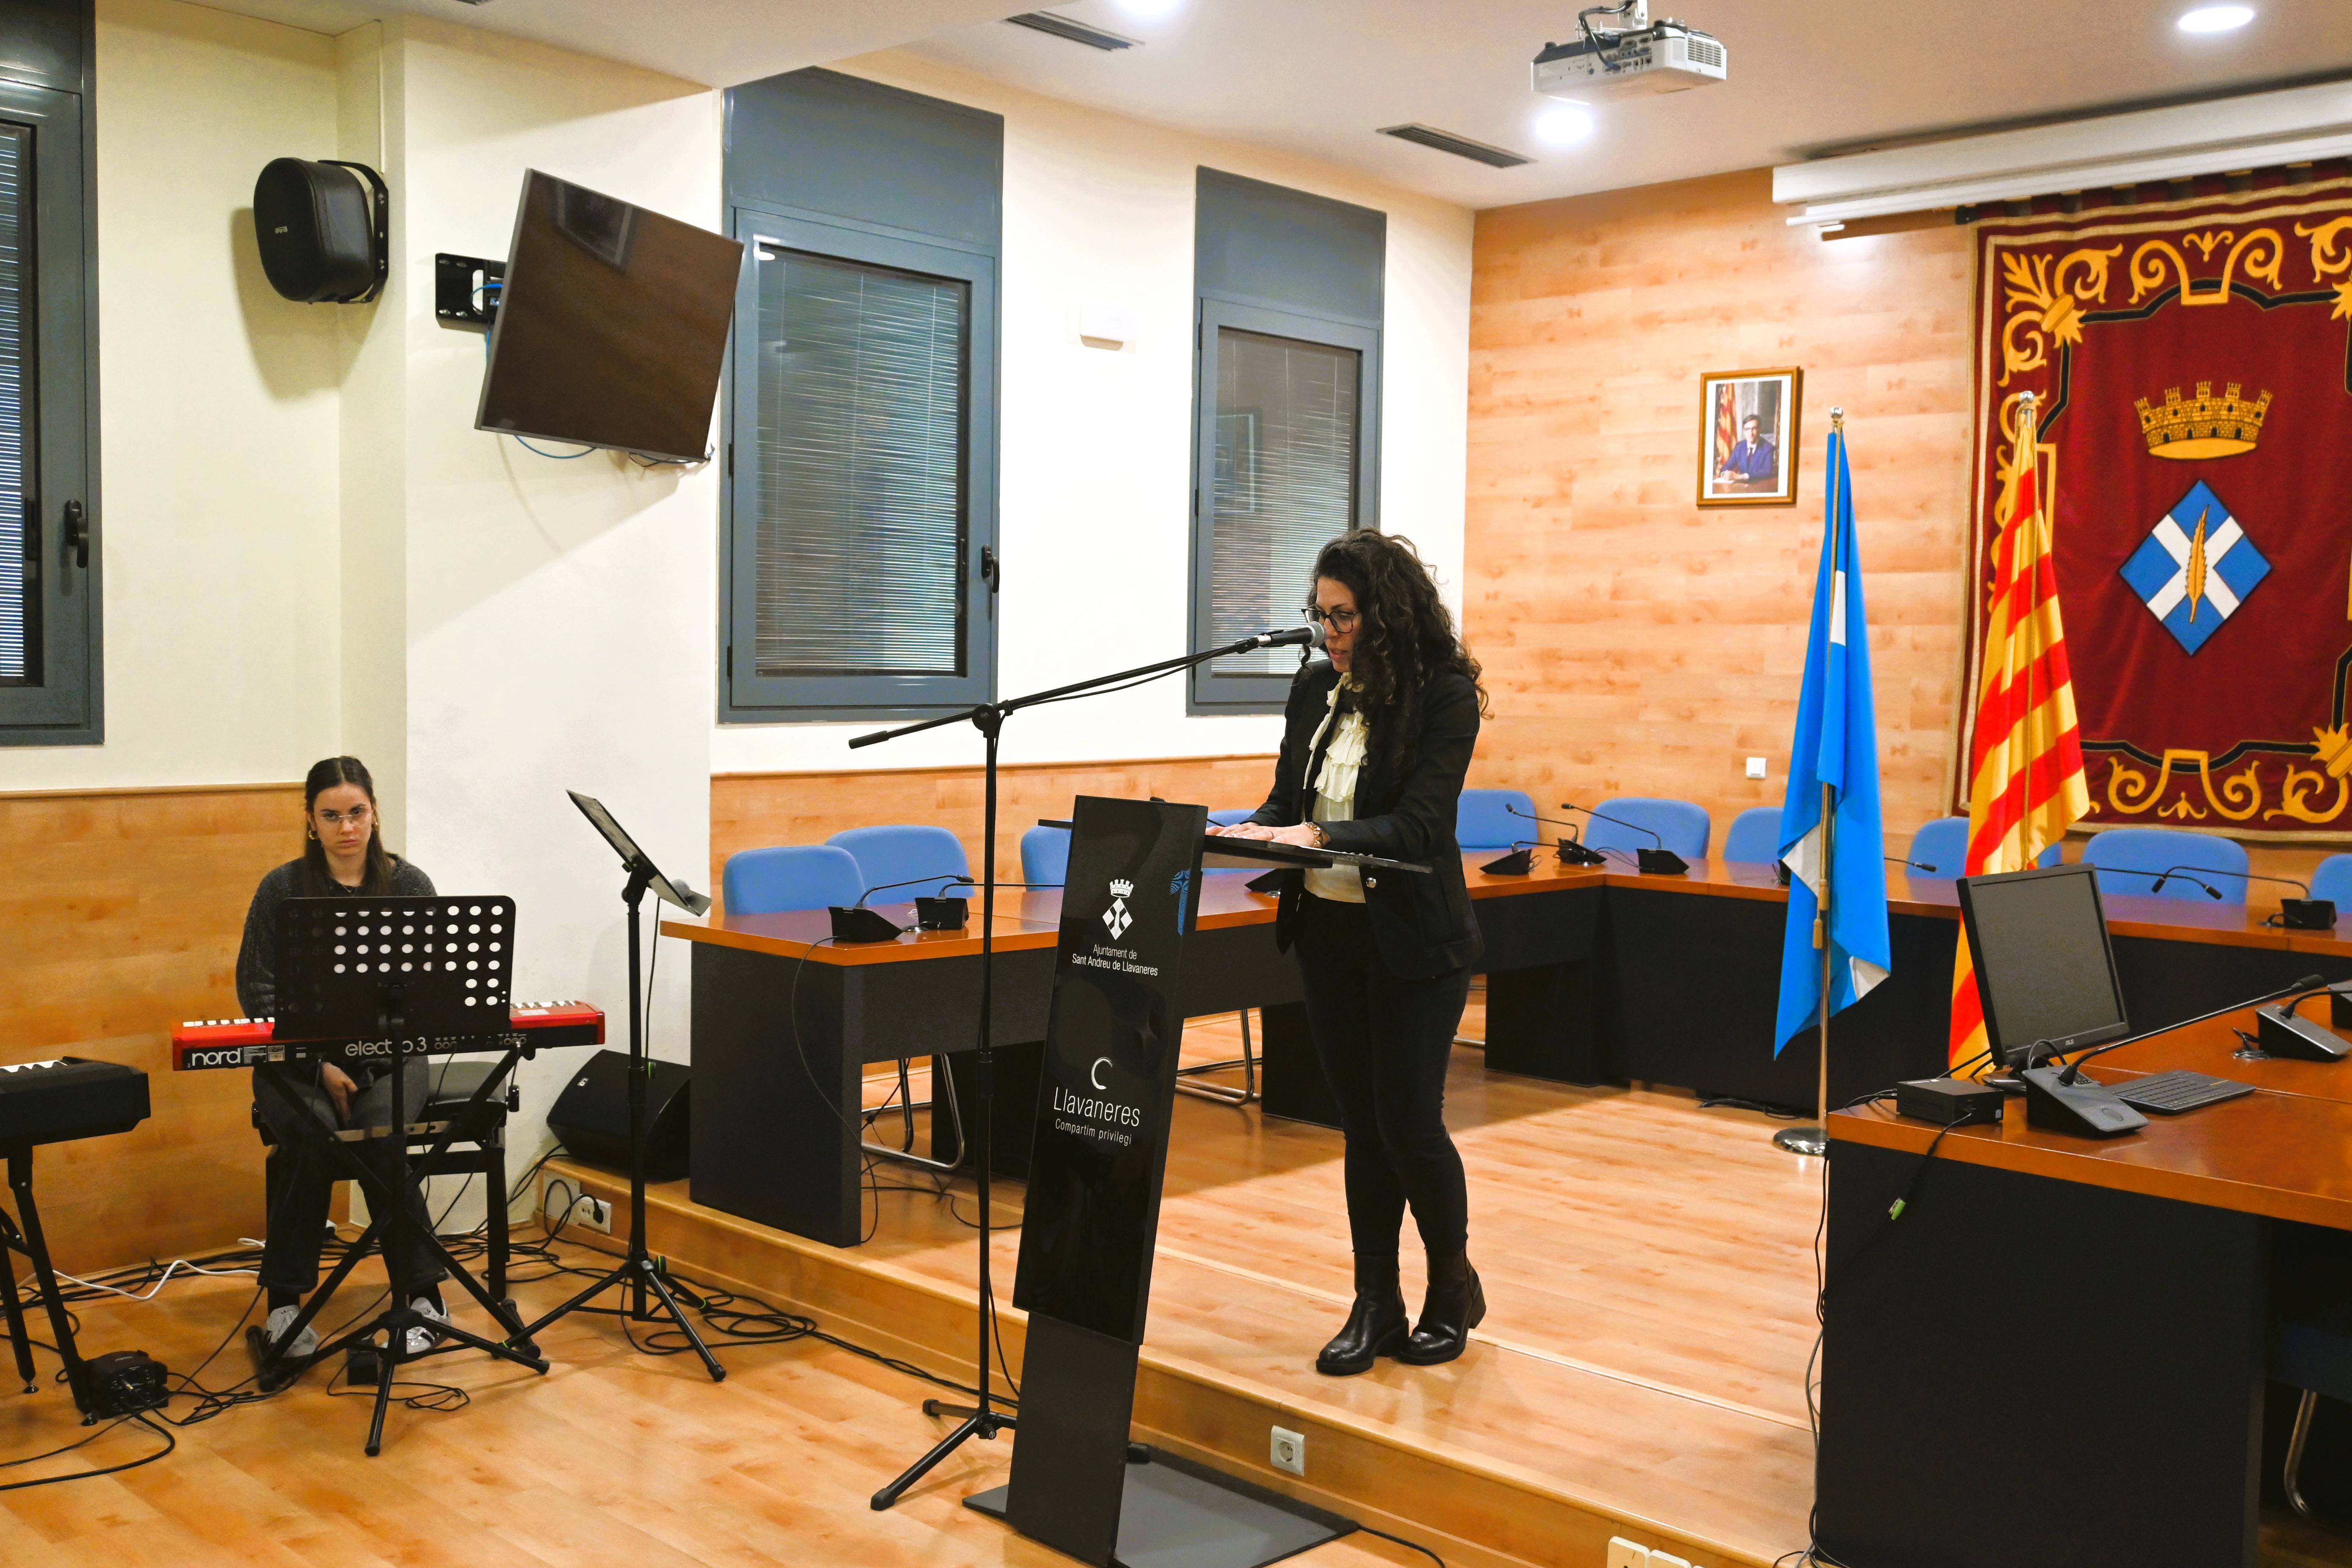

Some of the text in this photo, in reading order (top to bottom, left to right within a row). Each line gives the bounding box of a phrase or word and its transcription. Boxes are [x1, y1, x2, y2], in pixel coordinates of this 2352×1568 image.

[1072, 953, 1158, 976] Sant Andreu de Llavaneres
[1093, 944, 1137, 960] Ajuntament de
[192, 1048, 241, 1066] nord
[345, 1039, 414, 1056] electo
[1054, 1086, 1140, 1127] Llavaneres
[1056, 1118, 1132, 1146] Compartim privilegi
